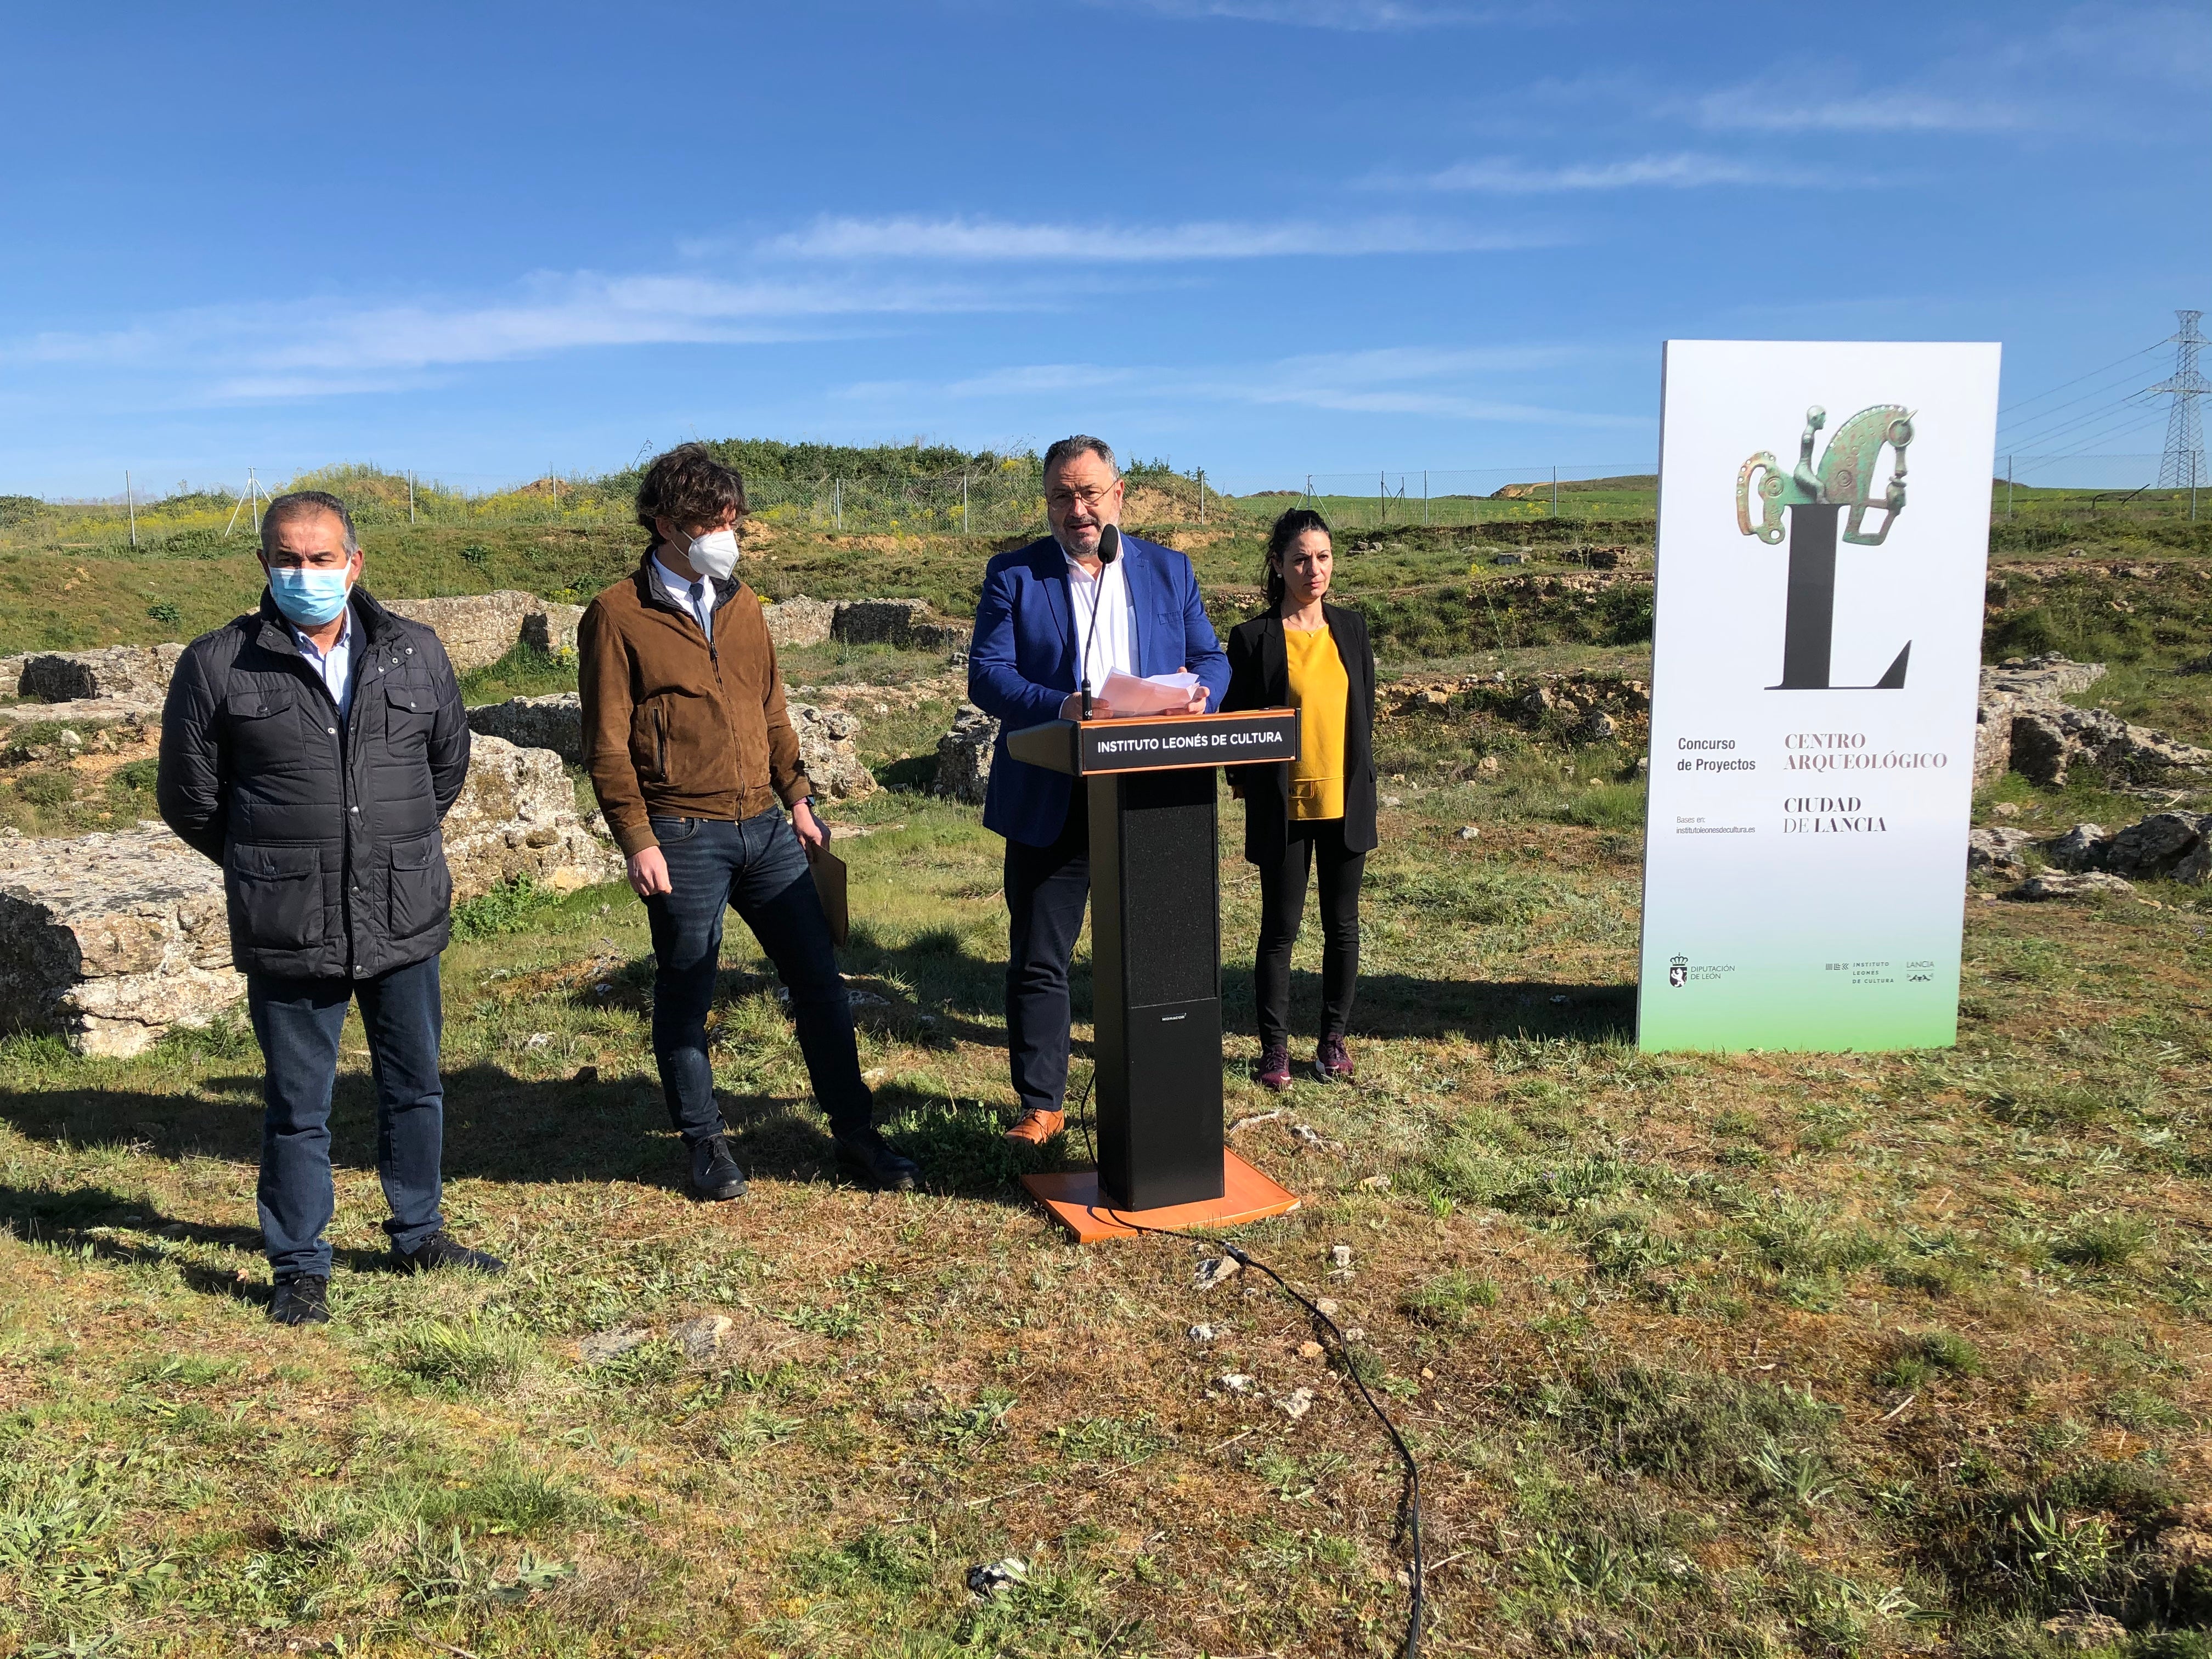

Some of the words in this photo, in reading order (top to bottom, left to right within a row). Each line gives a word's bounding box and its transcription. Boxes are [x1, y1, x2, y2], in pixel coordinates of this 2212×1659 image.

[1764, 503, 1912, 691] L
[1097, 737, 1159, 754] INSTITUTO
[1162, 732, 1208, 749] LEONÉS
[1211, 733, 1227, 746] DE
[1229, 731, 1283, 745] CULTURA
[1678, 737, 1736, 750] Concurso
[1784, 733, 1866, 749] CENTRO
[1677, 758, 1692, 771] de
[1696, 758, 1756, 773] Proyectos
[1783, 749, 1948, 773] ARQUEOLÓGICO
[1784, 797, 1861, 813] CIUDAD
[1782, 818, 1809, 833] DE
[1814, 817, 1887, 833] LANCIA
[1691, 964, 1735, 974] DIPUTACIÓN
